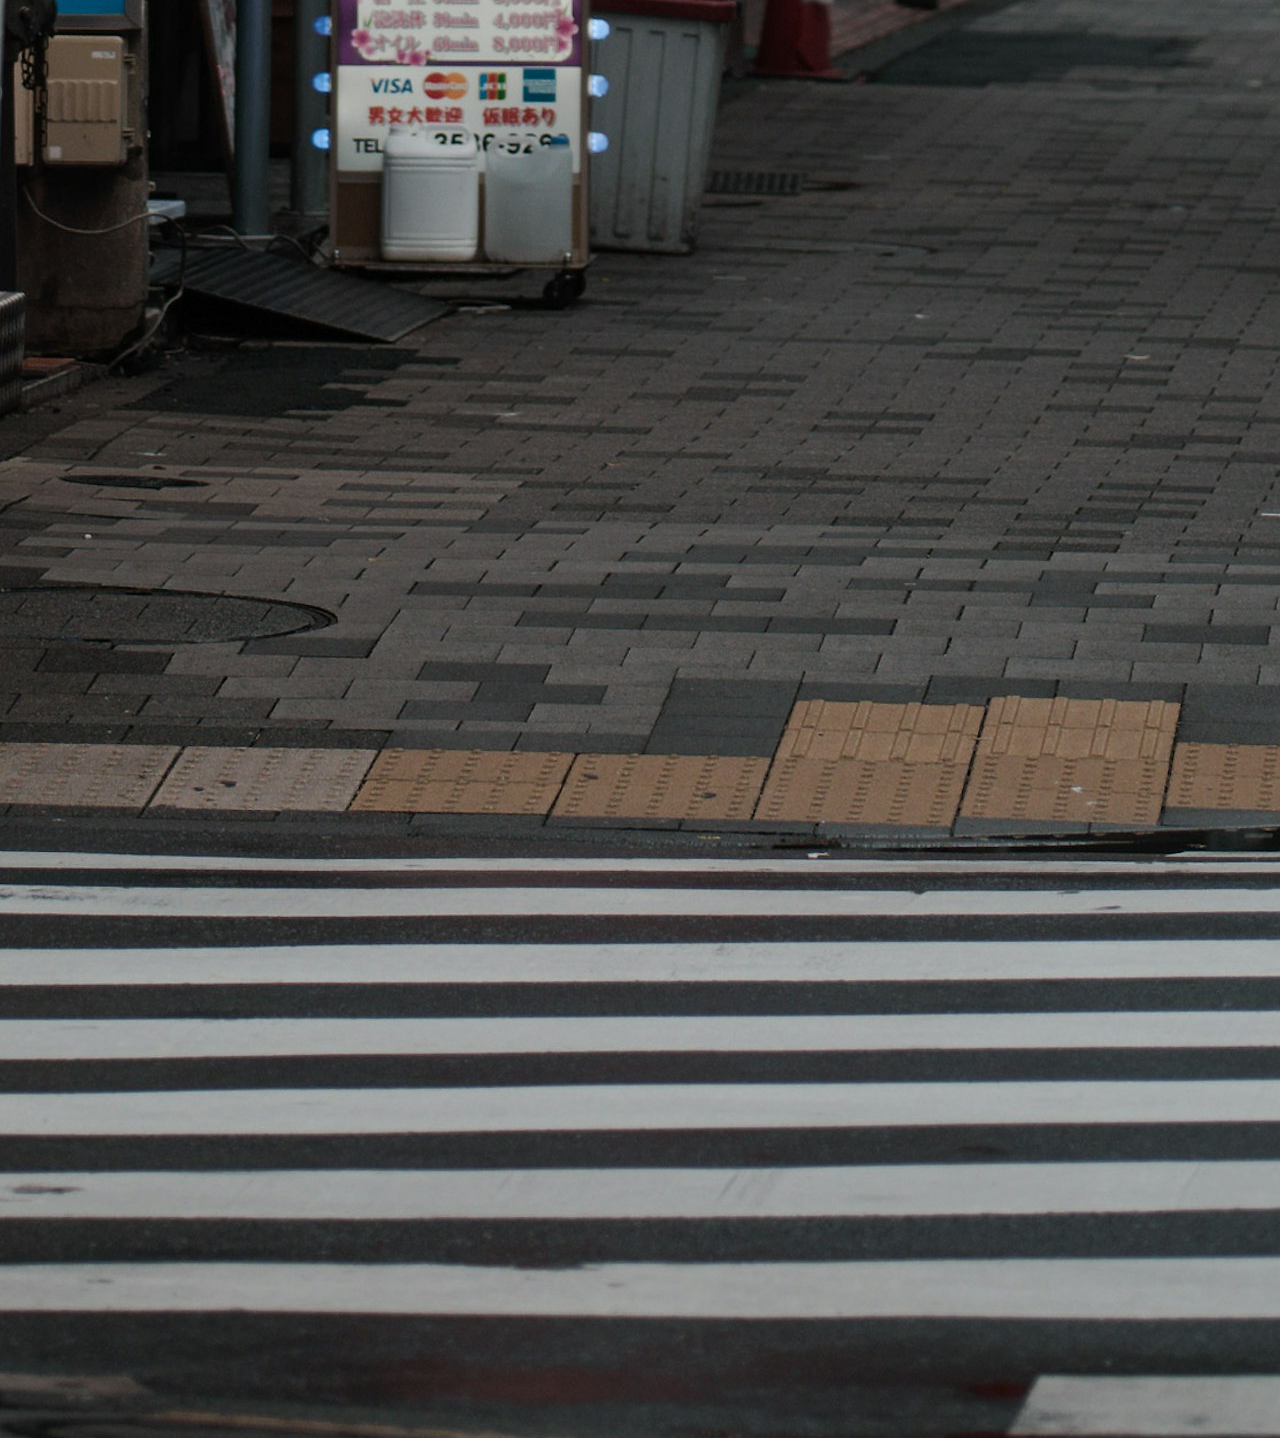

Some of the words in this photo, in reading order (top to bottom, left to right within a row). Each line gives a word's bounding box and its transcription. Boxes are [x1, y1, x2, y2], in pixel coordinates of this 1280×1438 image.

[369, 77, 414, 94] VISA
[482, 106, 558, 125] 仮眠あり
[352, 138, 384, 154] TEL
